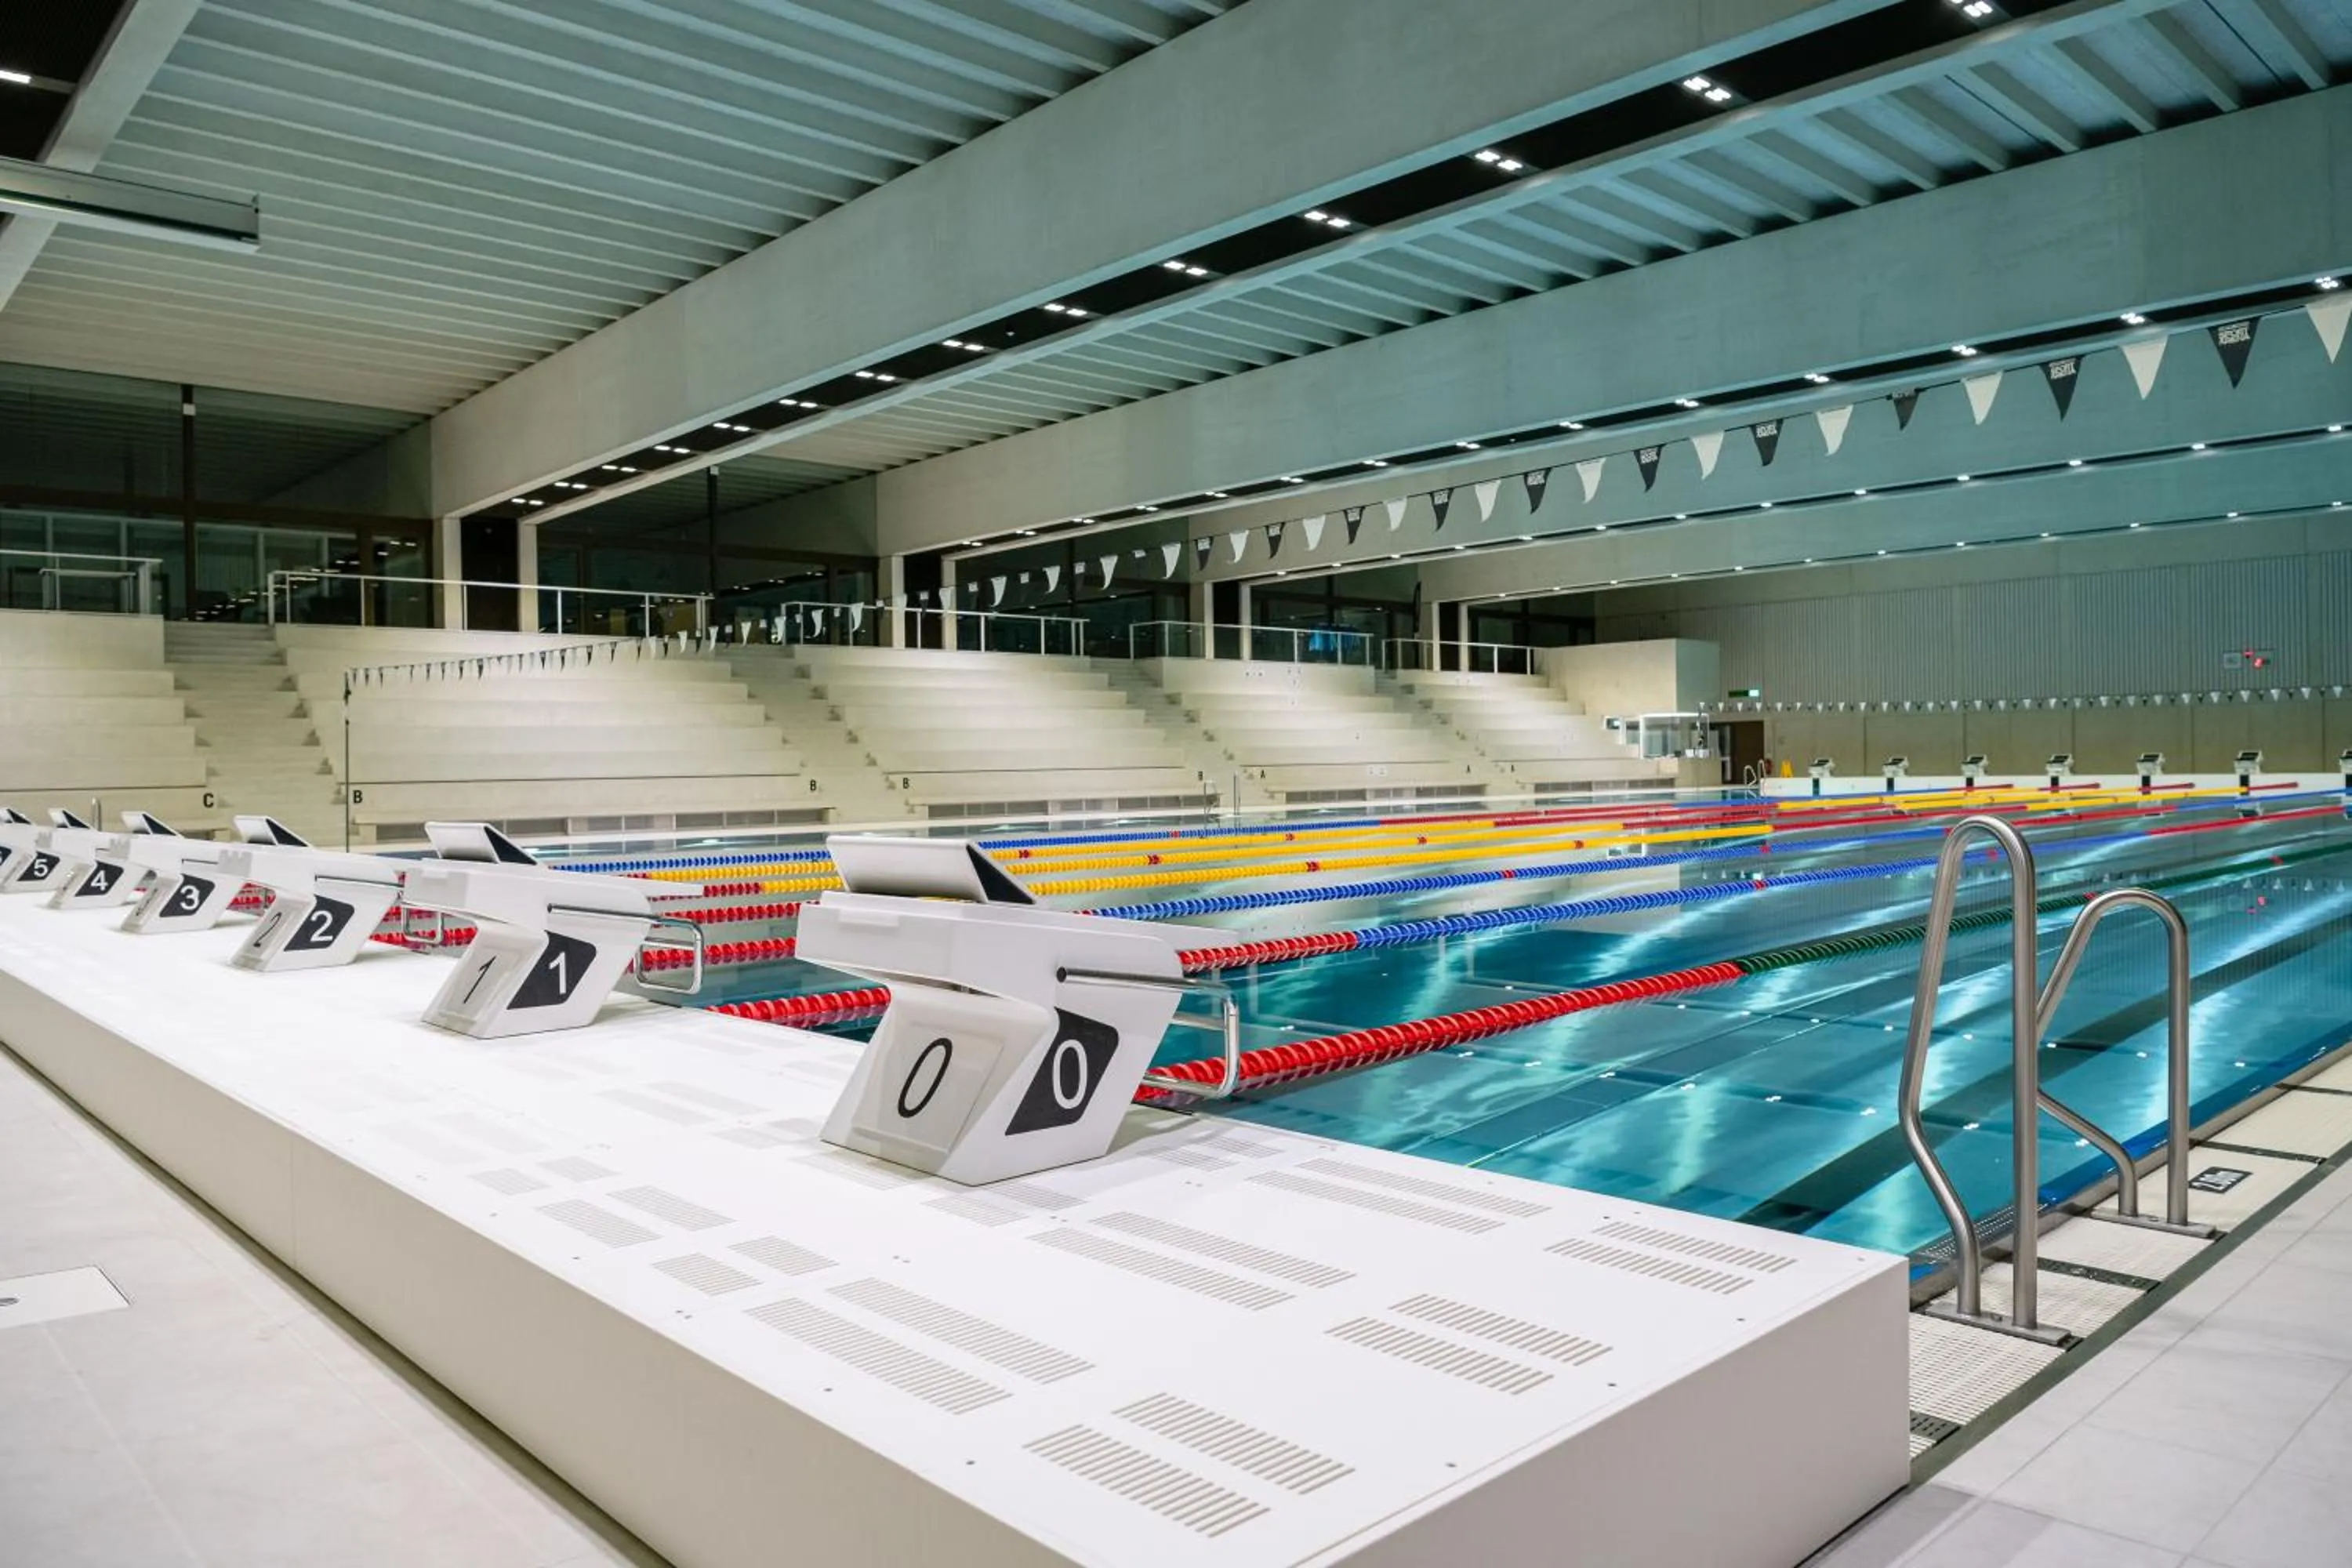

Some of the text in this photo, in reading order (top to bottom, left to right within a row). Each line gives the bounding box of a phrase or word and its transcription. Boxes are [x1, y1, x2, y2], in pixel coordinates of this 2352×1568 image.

[353, 789, 364, 804] B
[810, 779, 817, 791] B
[903, 777, 909, 789] B
[202, 793, 215, 808] C
[34, 858, 49, 877] 5
[90, 869, 109, 891] 4
[180, 884, 201, 911] 3
[252, 912, 282, 948] 2
[310, 910, 333, 942] 2
[463, 955, 497, 1004] 1
[549, 951, 567, 996] 1
[898, 1037, 953, 1118] 0
[1051, 1039, 1088, 1109] 0
